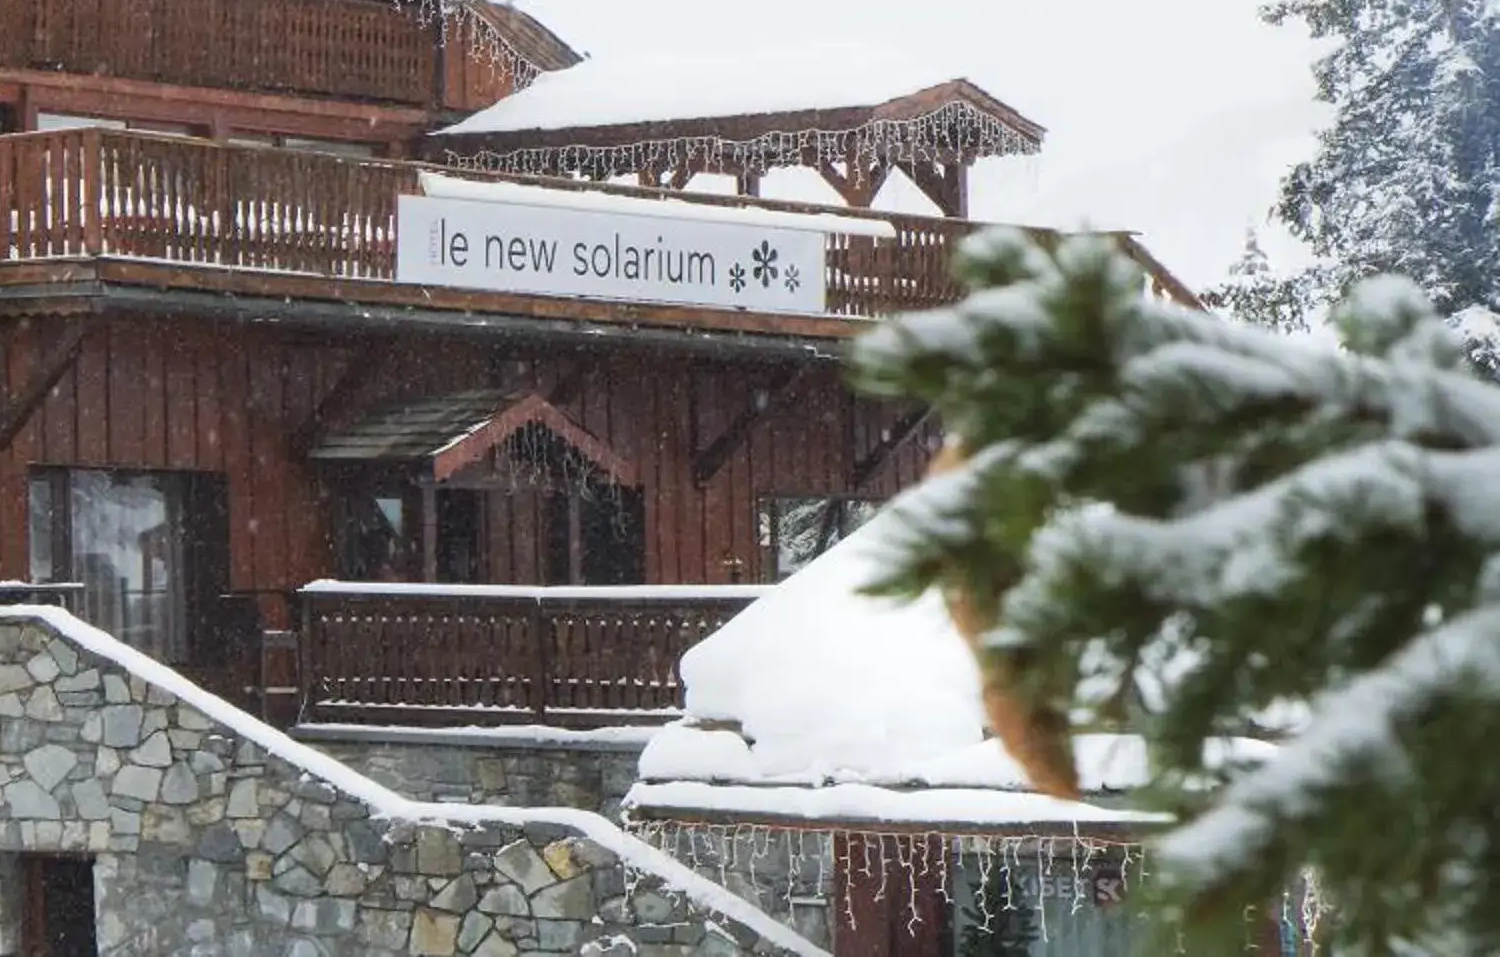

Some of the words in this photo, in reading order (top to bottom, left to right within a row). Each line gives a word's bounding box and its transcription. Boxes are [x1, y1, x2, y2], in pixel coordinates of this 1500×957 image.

[440, 218, 469, 267] le
[485, 233, 557, 273] new
[572, 233, 715, 285] solarium
